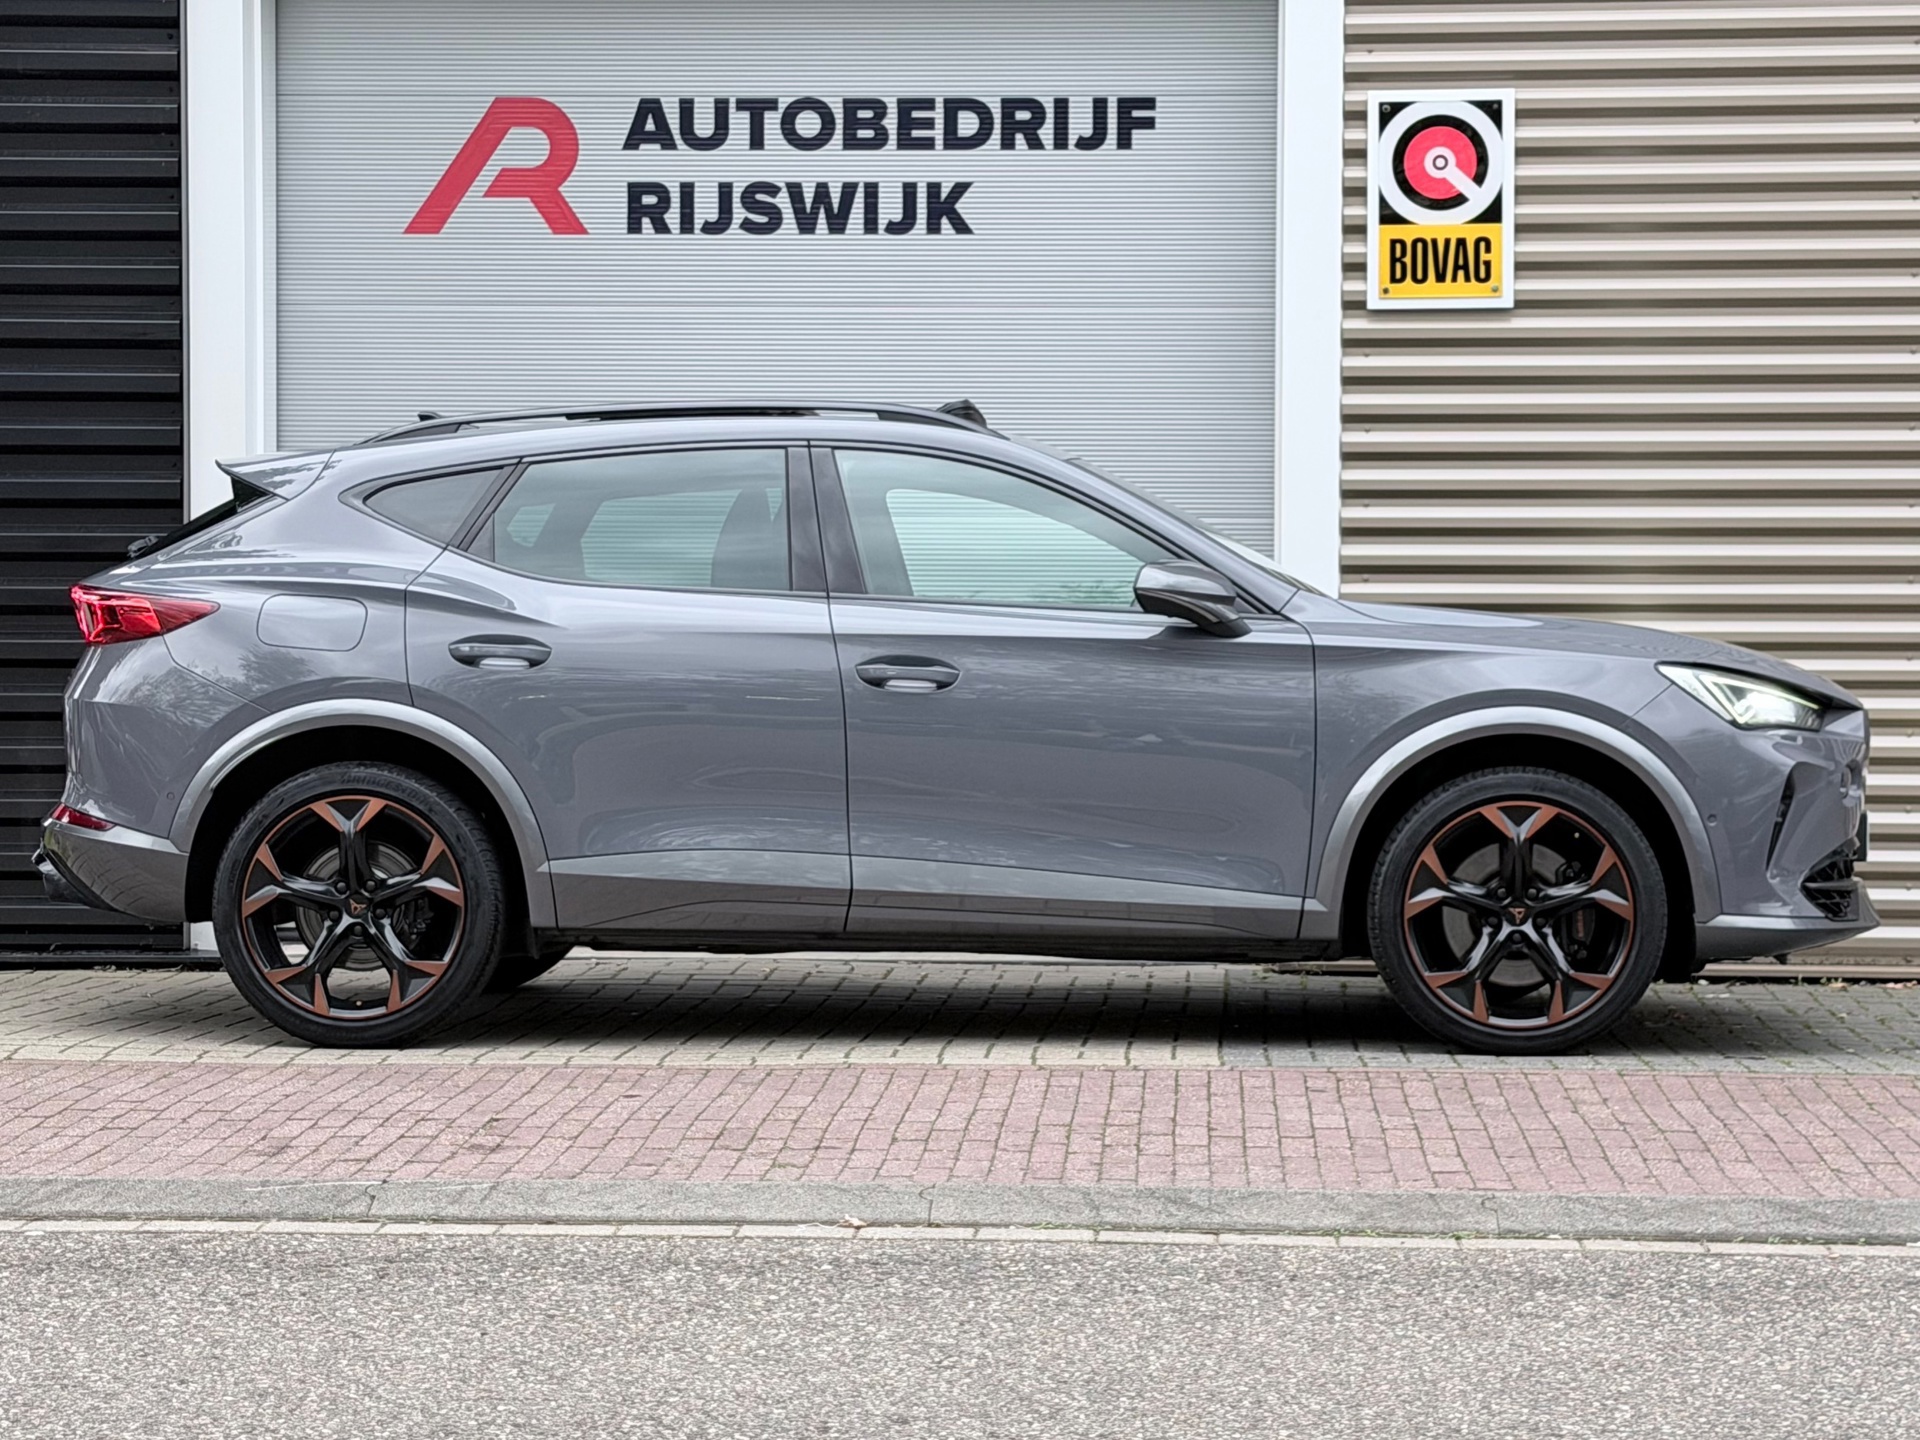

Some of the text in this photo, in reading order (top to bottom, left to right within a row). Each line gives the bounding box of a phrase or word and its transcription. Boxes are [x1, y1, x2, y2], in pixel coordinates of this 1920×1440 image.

[622, 96, 1156, 151] AUTOBEDRIJF
[627, 181, 975, 235] RIJSWIJK
[1389, 236, 1492, 284] BOVAG
